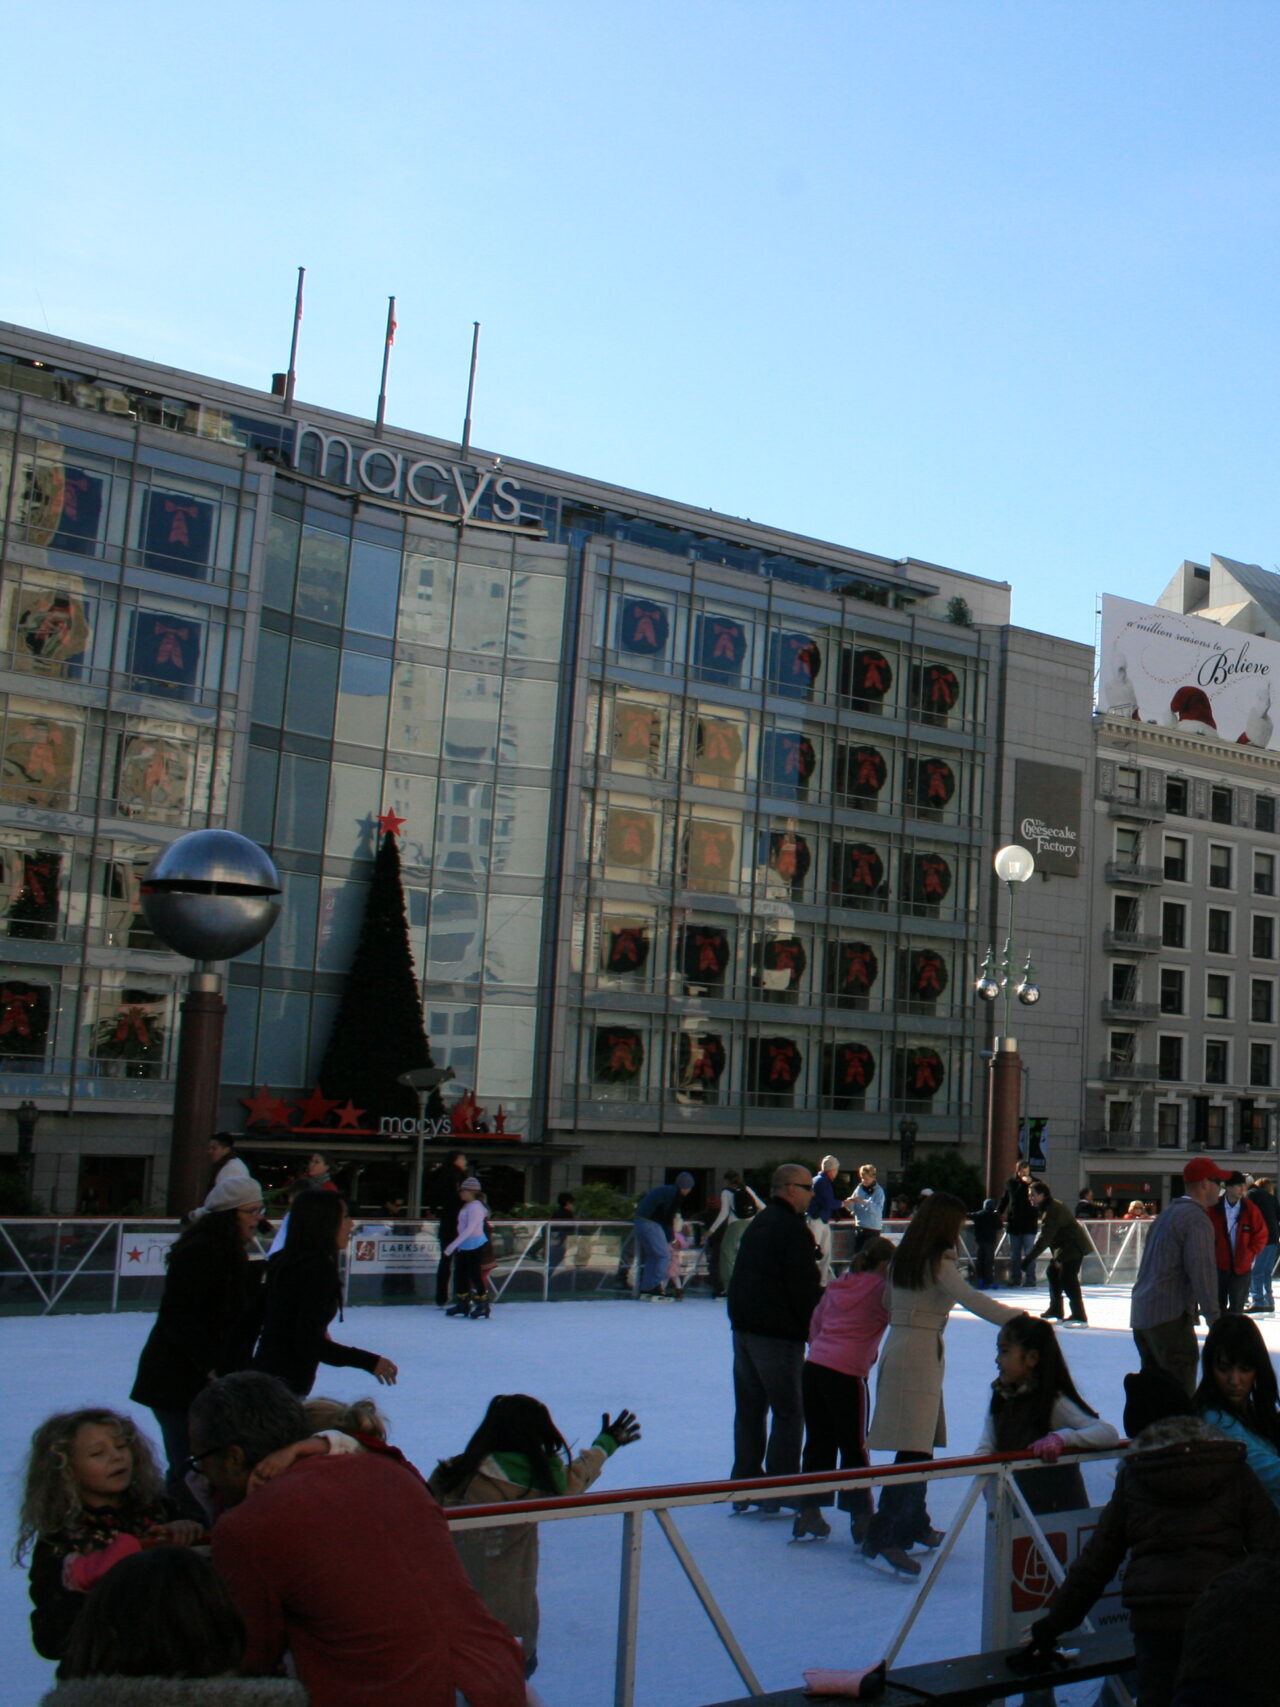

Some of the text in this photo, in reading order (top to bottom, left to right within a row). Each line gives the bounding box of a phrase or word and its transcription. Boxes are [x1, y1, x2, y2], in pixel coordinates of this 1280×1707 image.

[294, 419, 521, 525] macy's
[1136, 622, 1173, 638] million
[1176, 632, 1211, 649] reasons
[1213, 643, 1223, 651] to
[1197, 641, 1271, 687] Believe
[1021, 818, 1077, 840] Cheesecake
[1032, 834, 1077, 858] Factory
[380, 1114, 452, 1138] macy's
